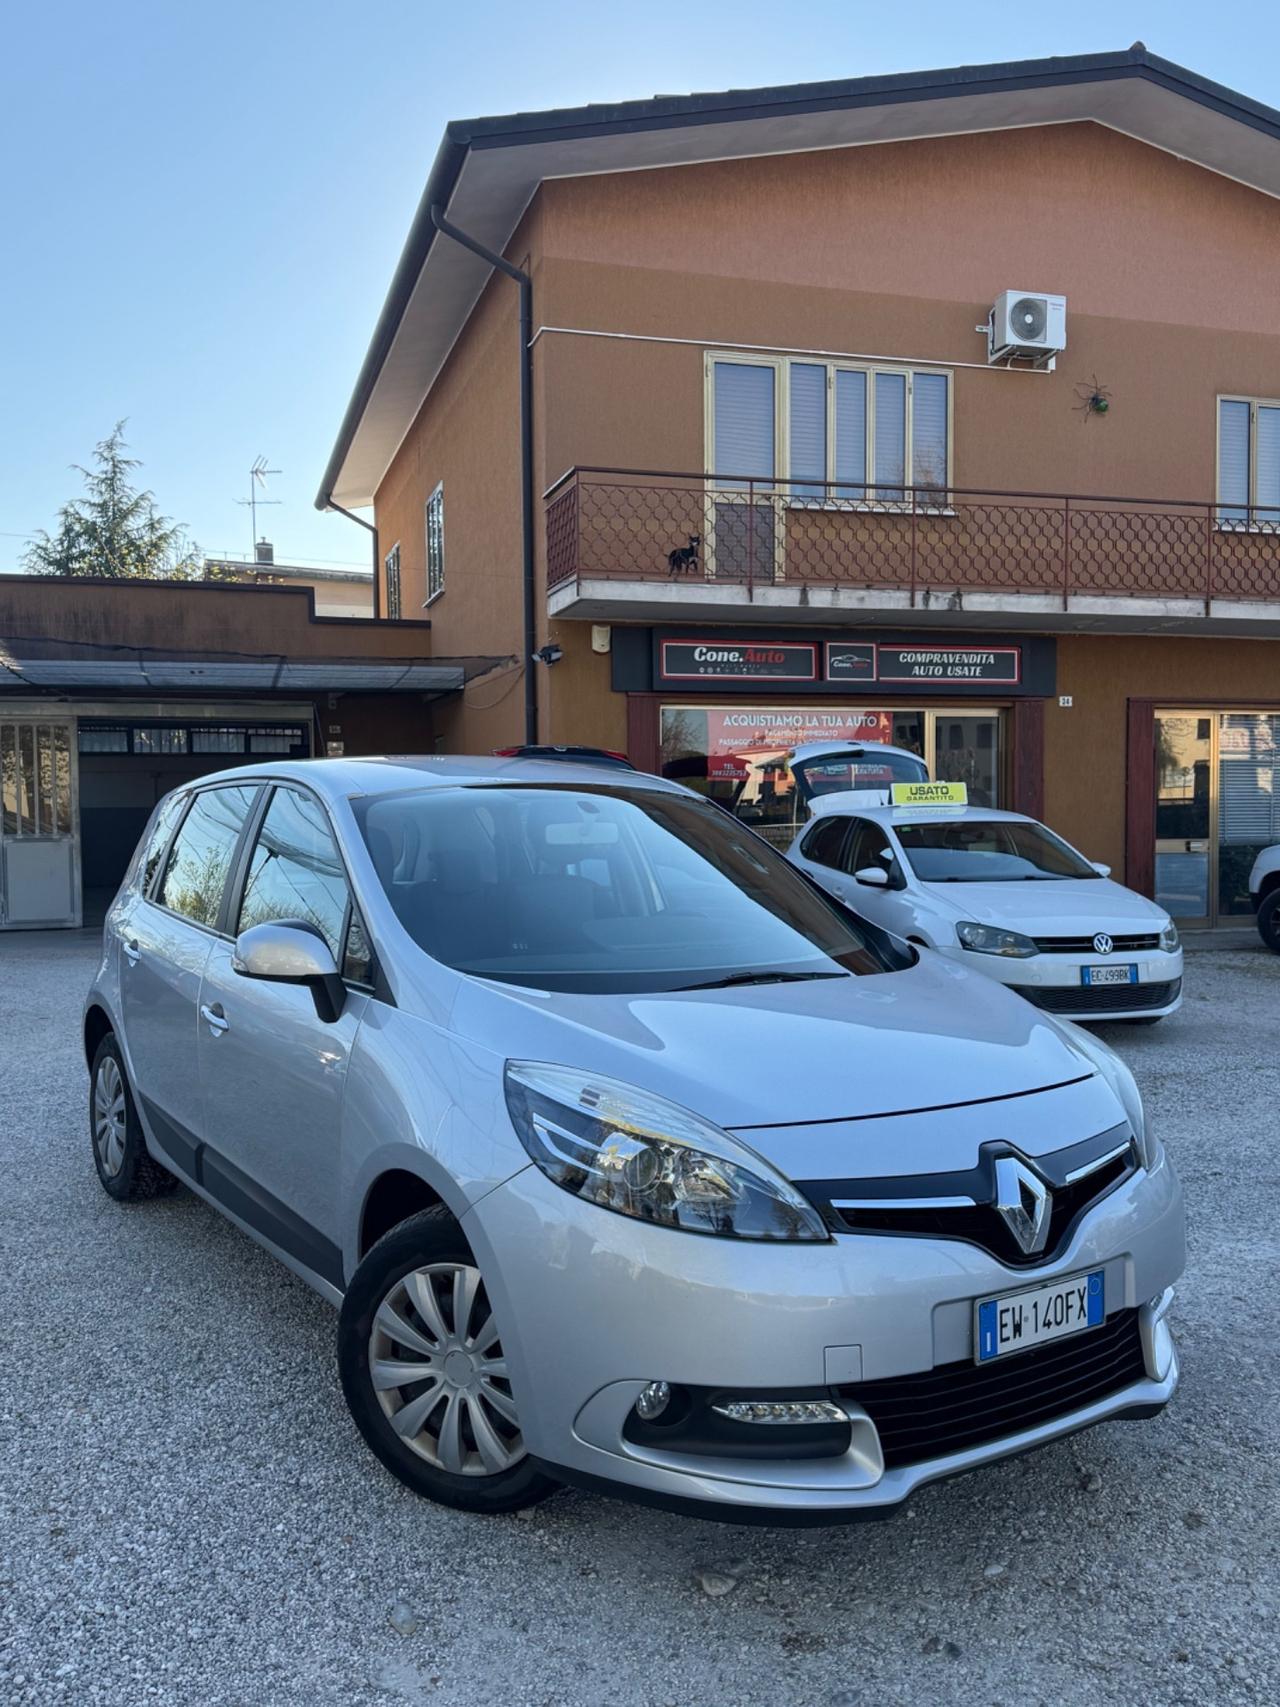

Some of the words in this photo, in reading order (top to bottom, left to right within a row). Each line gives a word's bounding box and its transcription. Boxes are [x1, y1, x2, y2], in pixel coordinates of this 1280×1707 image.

[694, 646, 785, 663] Cone.Auto
[899, 652, 995, 664] COMPRAVENDITA
[912, 666, 943, 676] AUTO
[947, 666, 983, 677] USATE
[723, 715, 803, 727] ACQUISTIAMO
[806, 715, 819, 726] LA
[822, 716, 844, 727] TUA
[846, 716, 877, 727] AUTO
[909, 786, 949, 796] USATO
